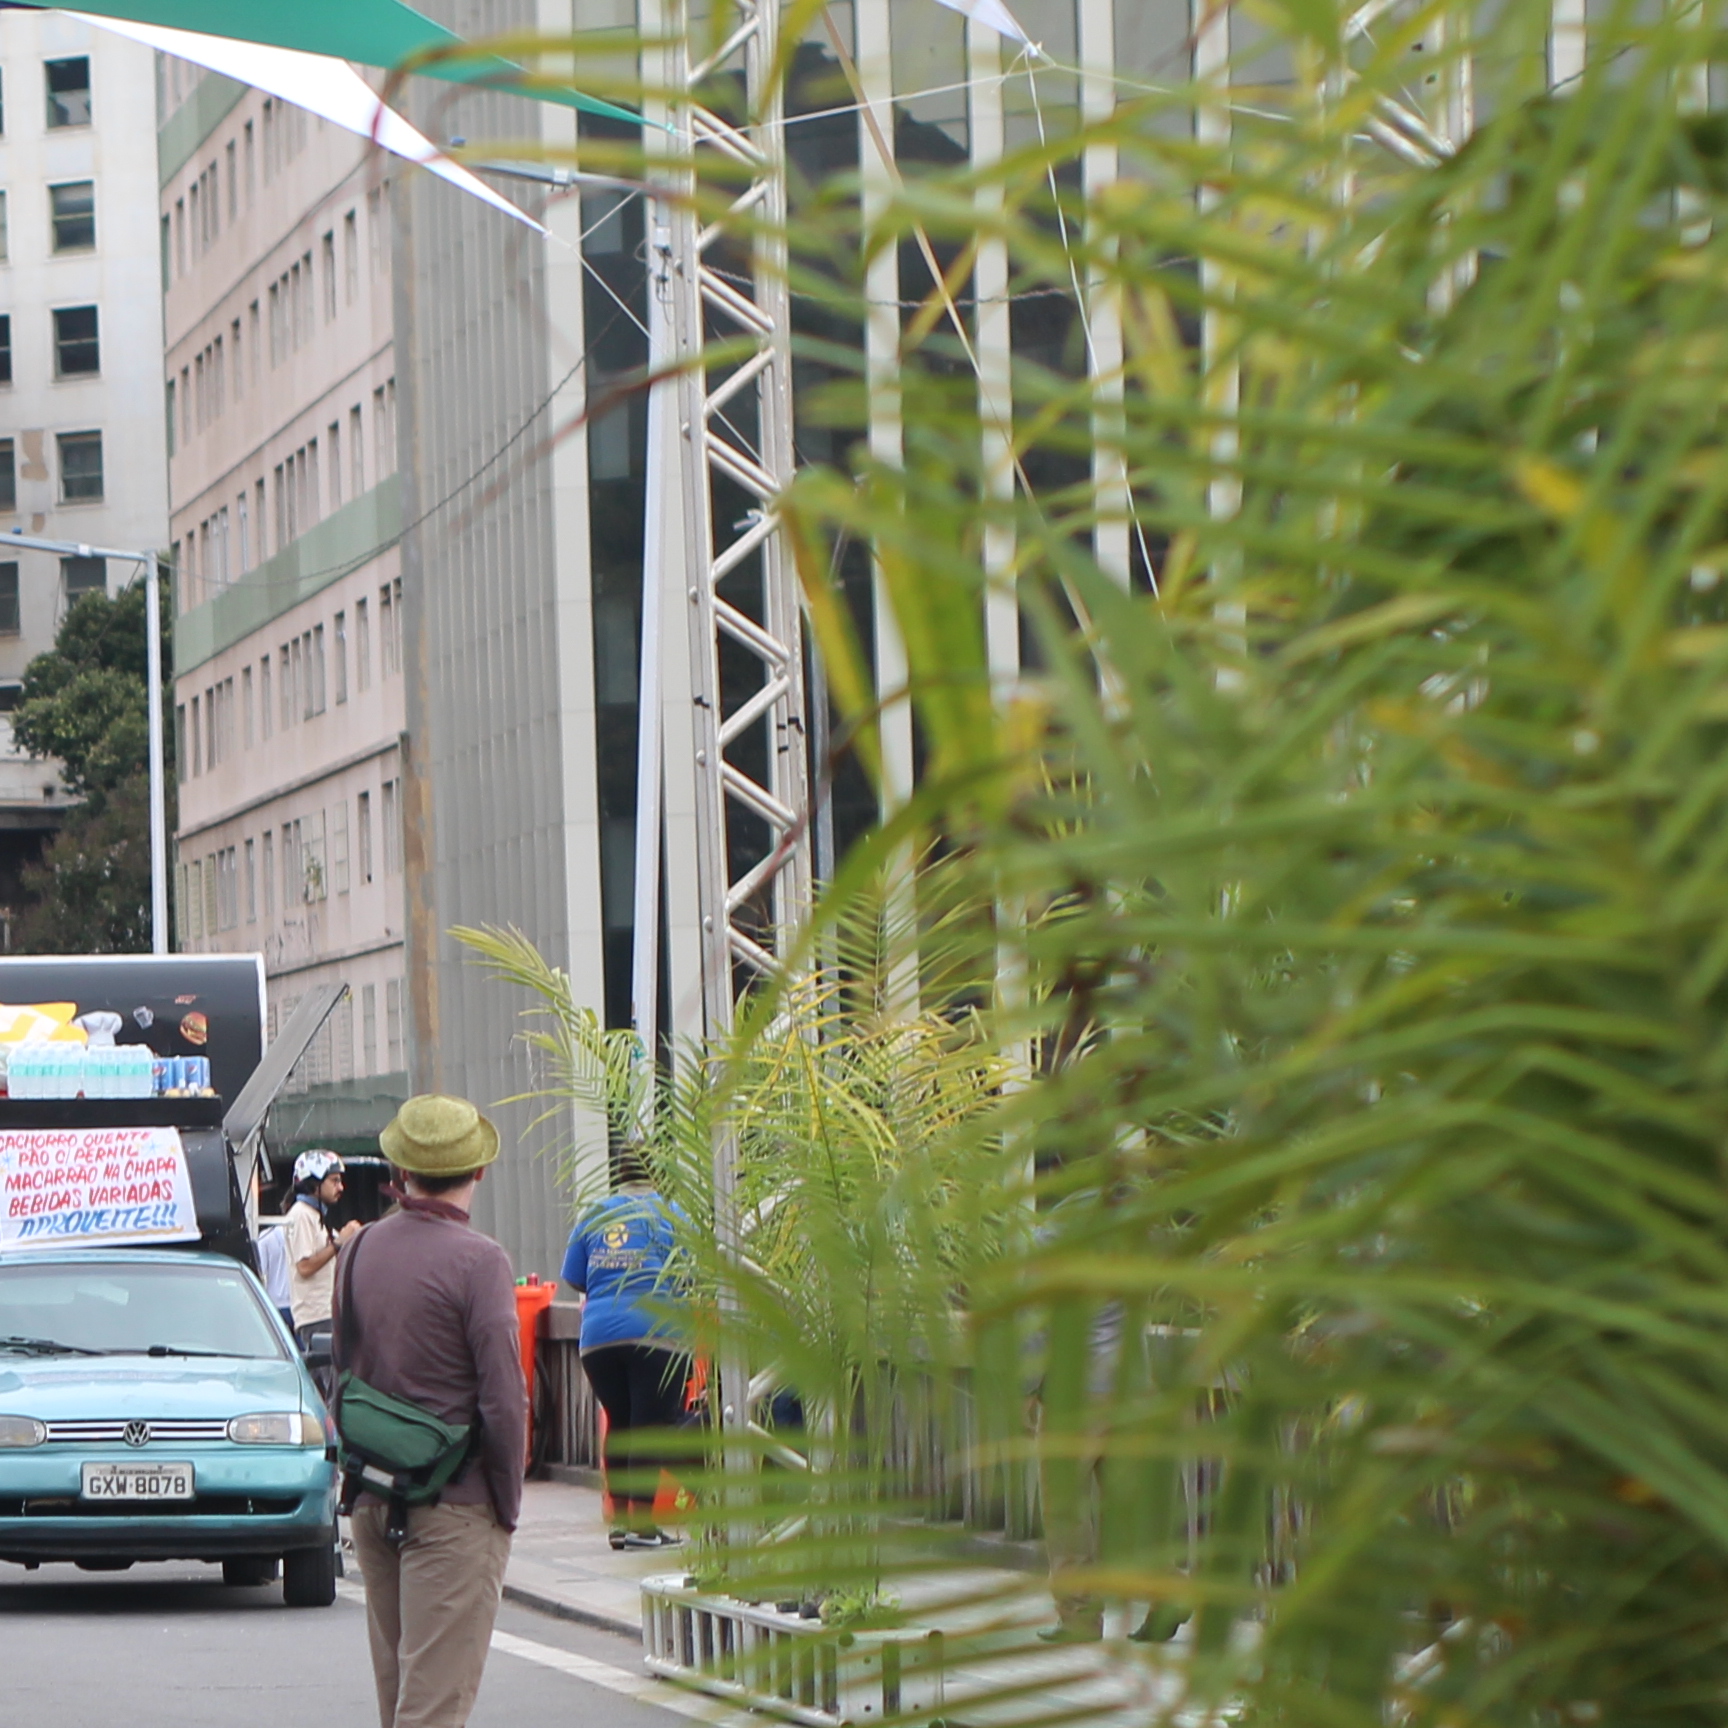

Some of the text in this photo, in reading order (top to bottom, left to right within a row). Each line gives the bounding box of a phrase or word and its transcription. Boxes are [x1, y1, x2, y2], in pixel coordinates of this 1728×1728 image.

[5, 1156, 177, 1192] MACARRÃO NA CHAPA
[8, 1178, 173, 1218] BEBIDAS VARIADAS
[17, 1202, 178, 1238] APROVEITE!!!
